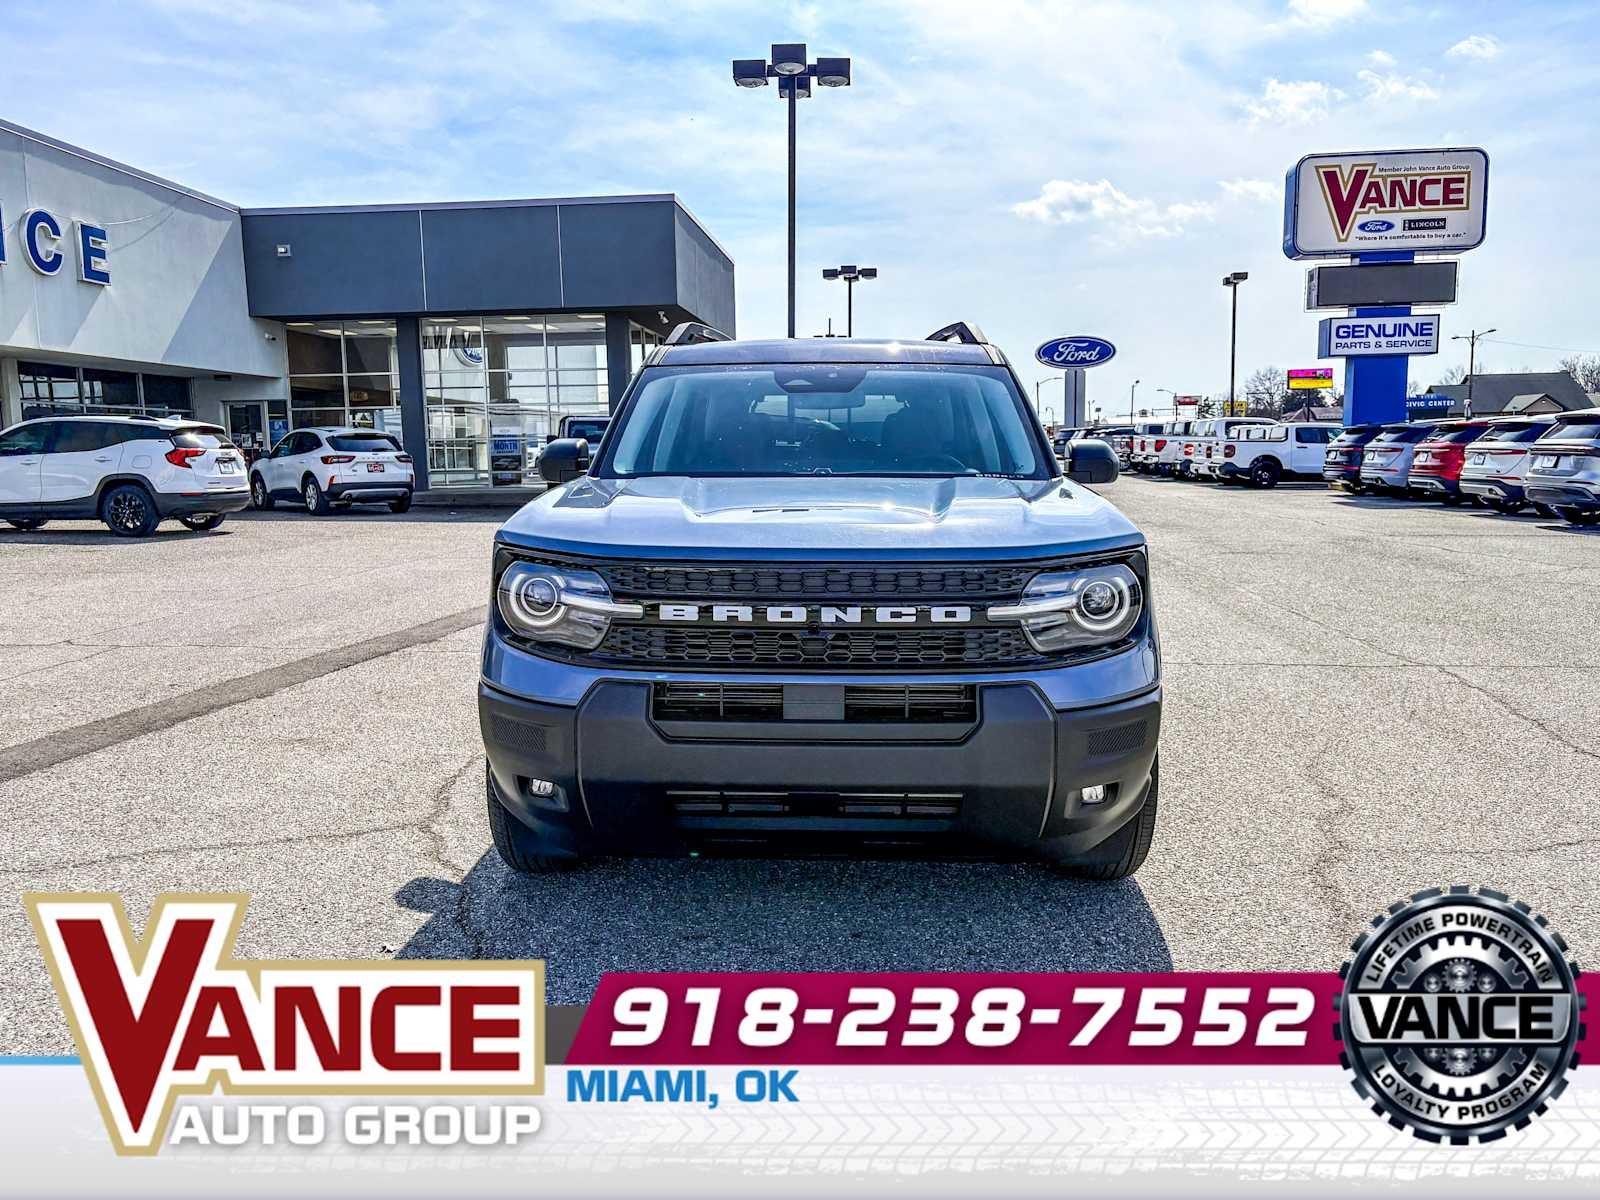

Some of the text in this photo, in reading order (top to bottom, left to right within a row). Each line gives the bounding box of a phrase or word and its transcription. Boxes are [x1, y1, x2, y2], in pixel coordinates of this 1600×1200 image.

[1378, 165, 1402, 173] Member
[1322, 169, 1465, 235] VANCE
[1364, 221, 1388, 231] Ford
[1410, 220, 1445, 228] LINCOLN
[1335, 322, 1433, 339] GENUINE
[1053, 342, 1101, 361] Ford
[1335, 339, 1432, 350] PARTS & SERVICE
[659, 605, 971, 623] BRONCO
